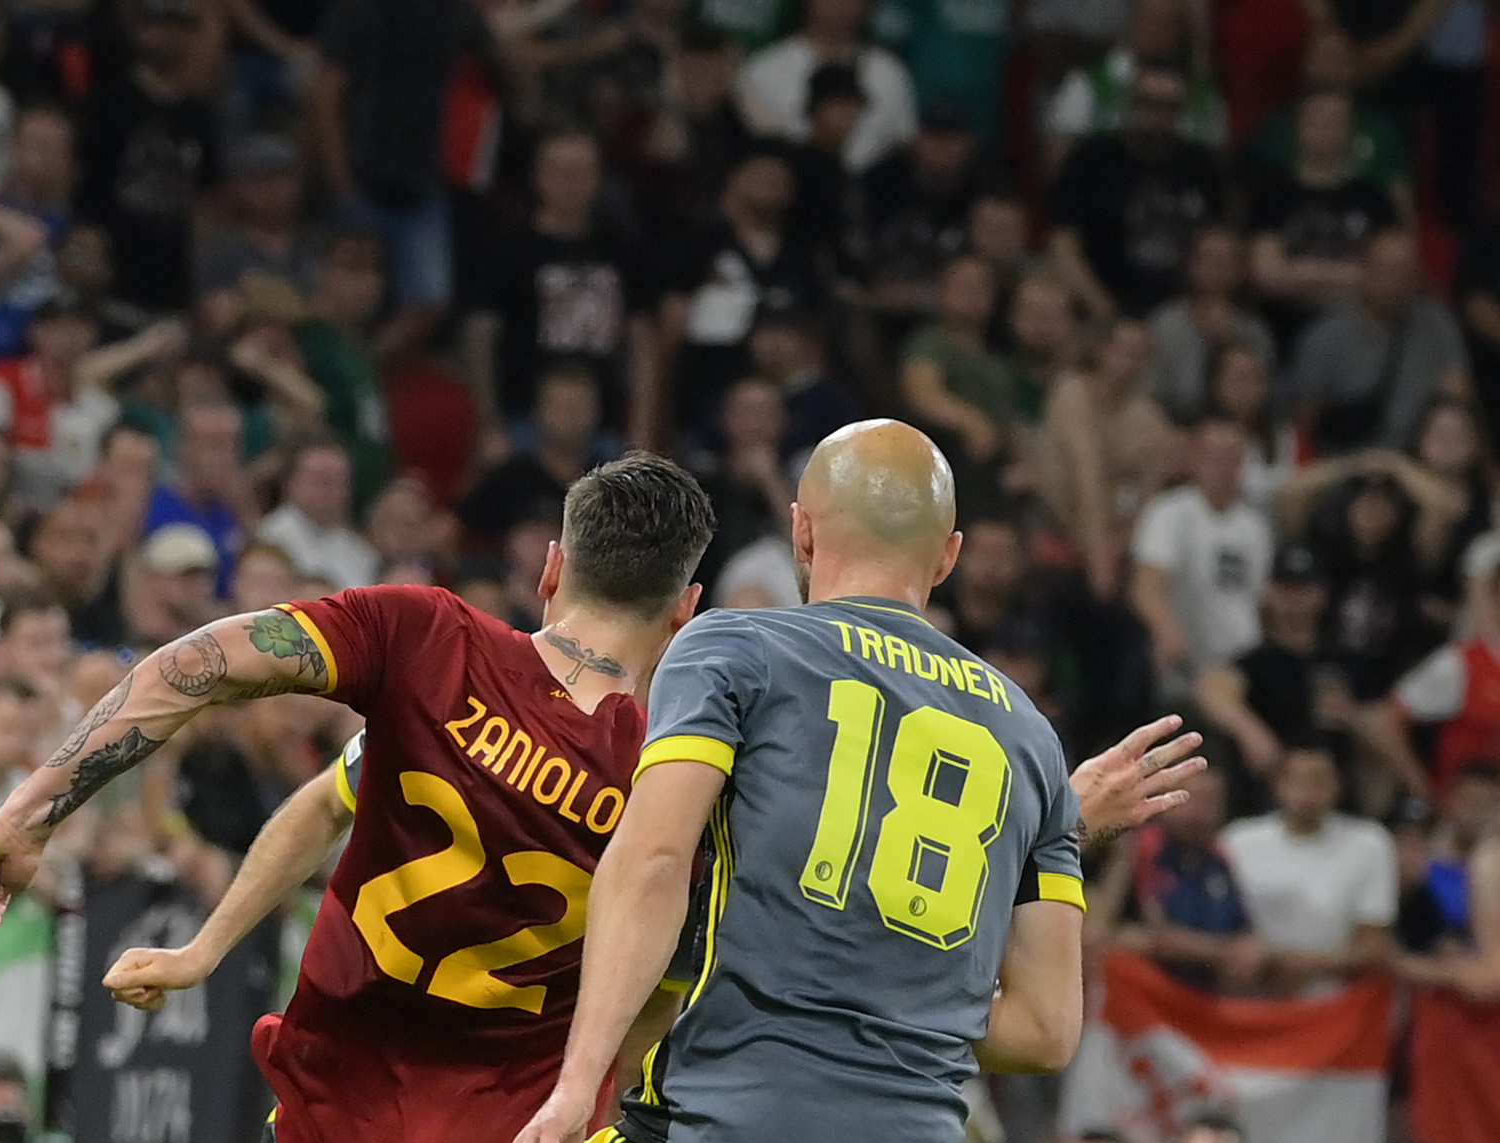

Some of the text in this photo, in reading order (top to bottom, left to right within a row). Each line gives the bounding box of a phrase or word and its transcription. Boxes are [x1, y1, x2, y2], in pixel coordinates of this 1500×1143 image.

[829, 620, 1012, 712] TRAUNER
[445, 695, 625, 835] ZANIOLO
[798, 679, 1012, 951] 18
[352, 770, 594, 1015] 22
